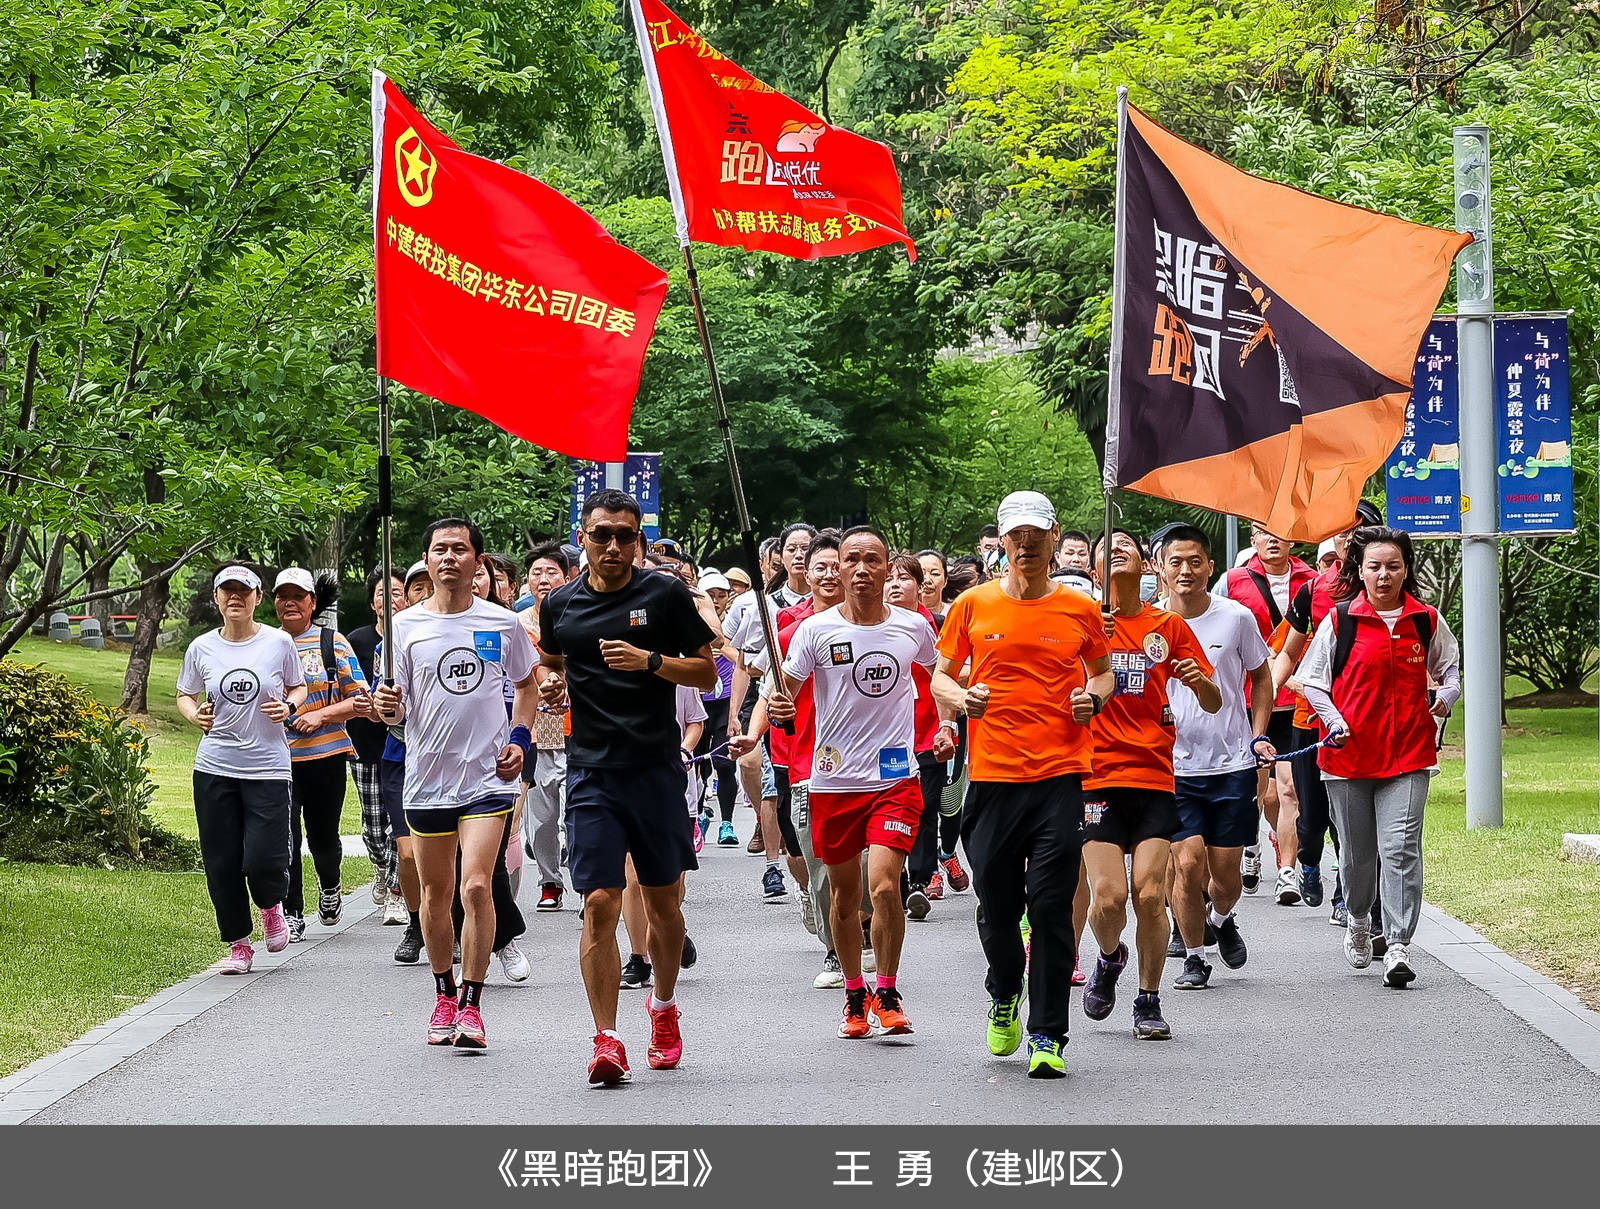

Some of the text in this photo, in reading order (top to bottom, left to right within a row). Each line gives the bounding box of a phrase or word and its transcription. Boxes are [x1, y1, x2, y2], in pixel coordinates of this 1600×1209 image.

[385, 215, 637, 338] 中建铁投集团华东公司团委
[1506, 362, 1525, 455] 仲夏露营夜
[1111, 652, 1146, 672] 黑暗
[819, 760, 834, 772] 36
